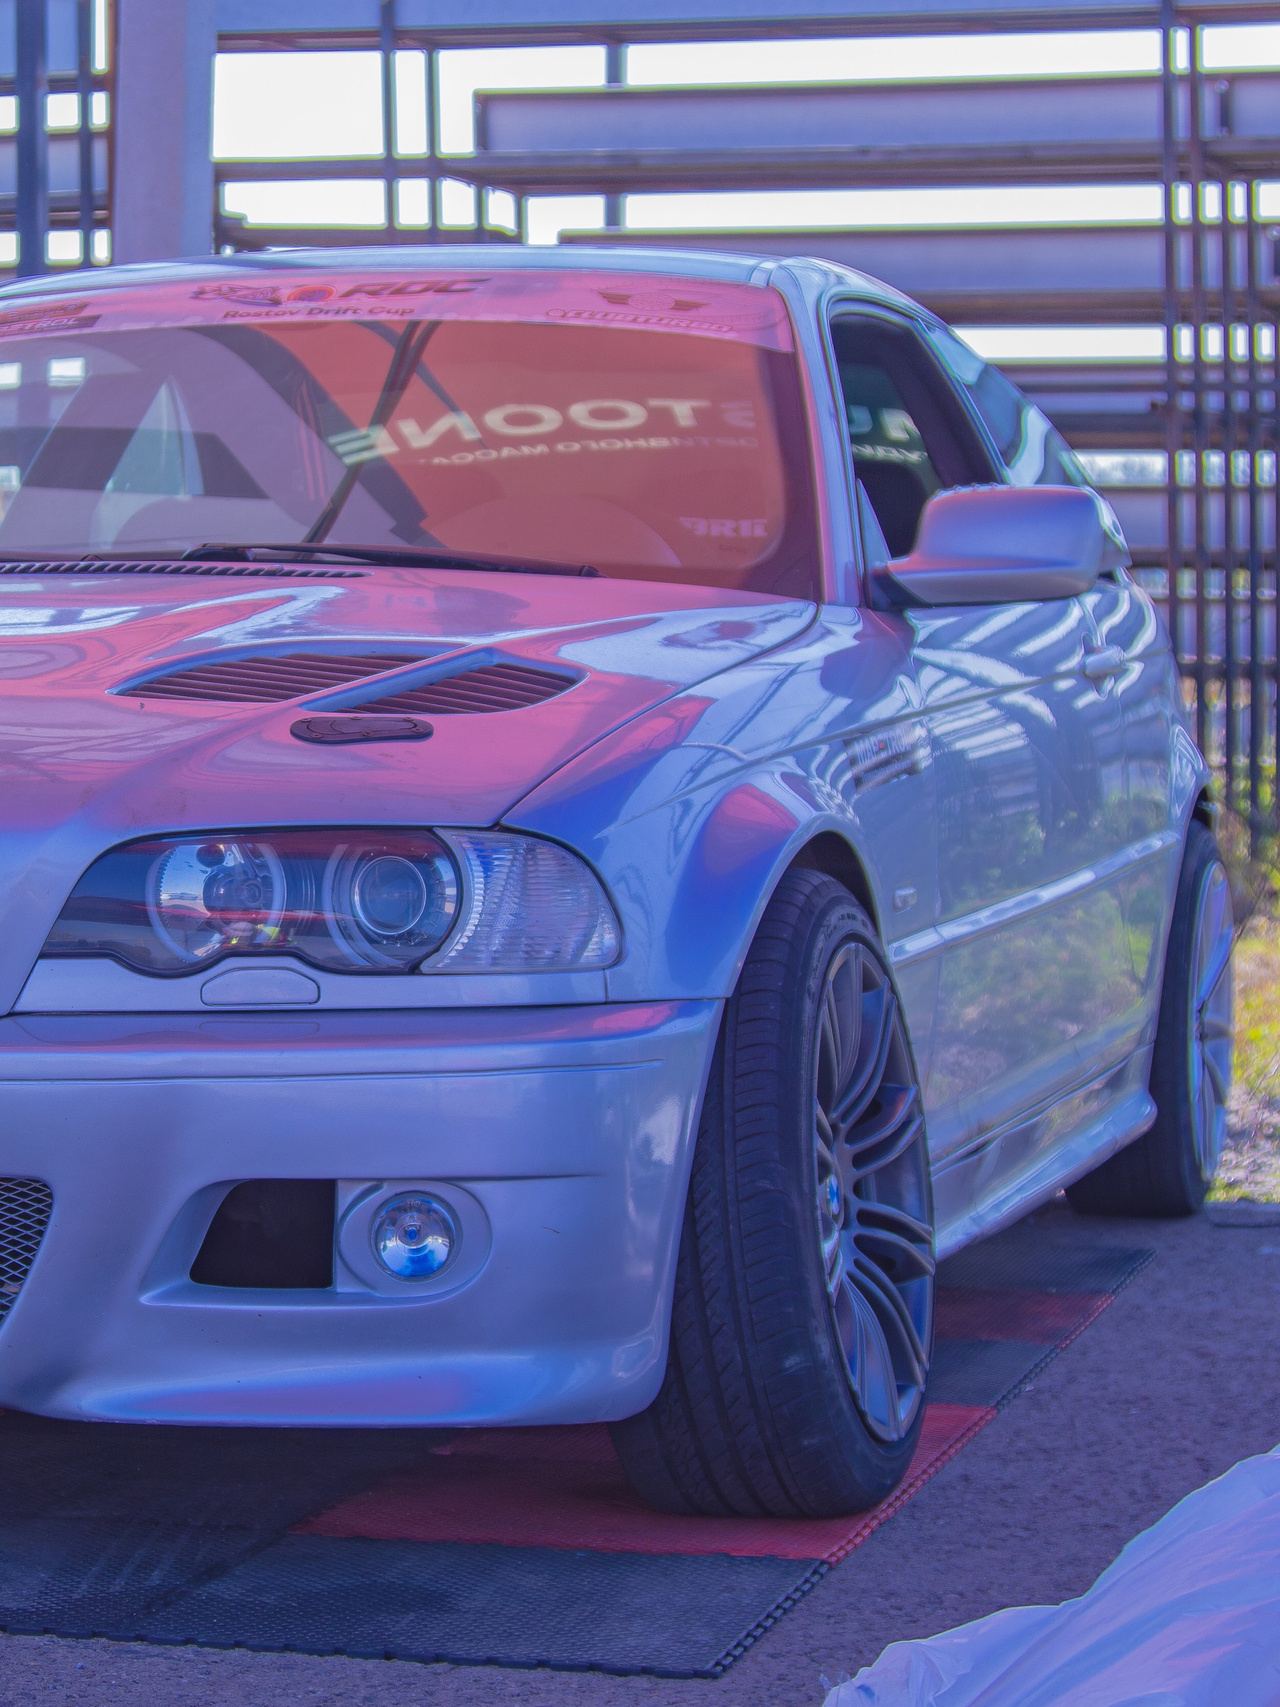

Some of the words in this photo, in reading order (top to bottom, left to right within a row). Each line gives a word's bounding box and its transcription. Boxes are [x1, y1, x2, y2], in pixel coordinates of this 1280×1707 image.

[222, 310, 301, 319] Rostov
[307, 305, 361, 315] Drift
[368, 305, 415, 316] Cup
